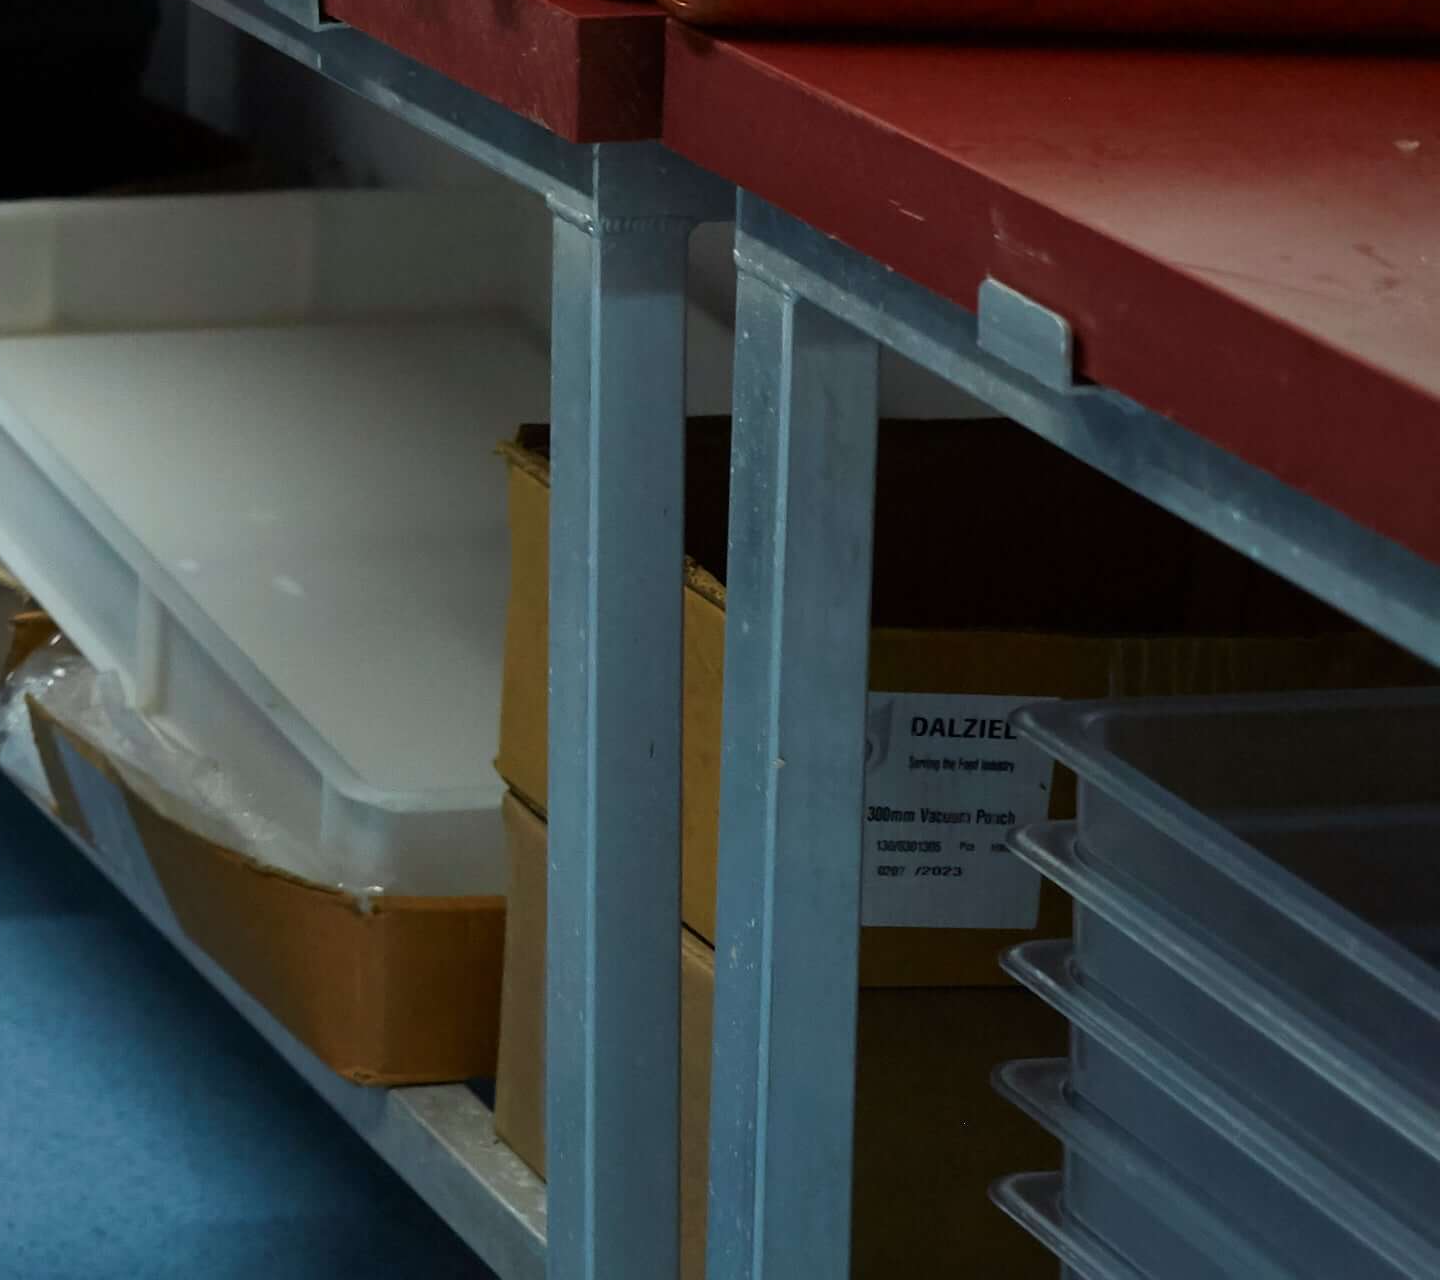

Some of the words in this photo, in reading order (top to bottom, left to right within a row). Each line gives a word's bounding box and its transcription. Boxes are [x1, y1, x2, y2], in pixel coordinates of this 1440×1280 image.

[911, 716, 1017, 740] DALZIEL
[920, 808, 971, 824] Vacuum
[976, 809, 1016, 825] Pouch
